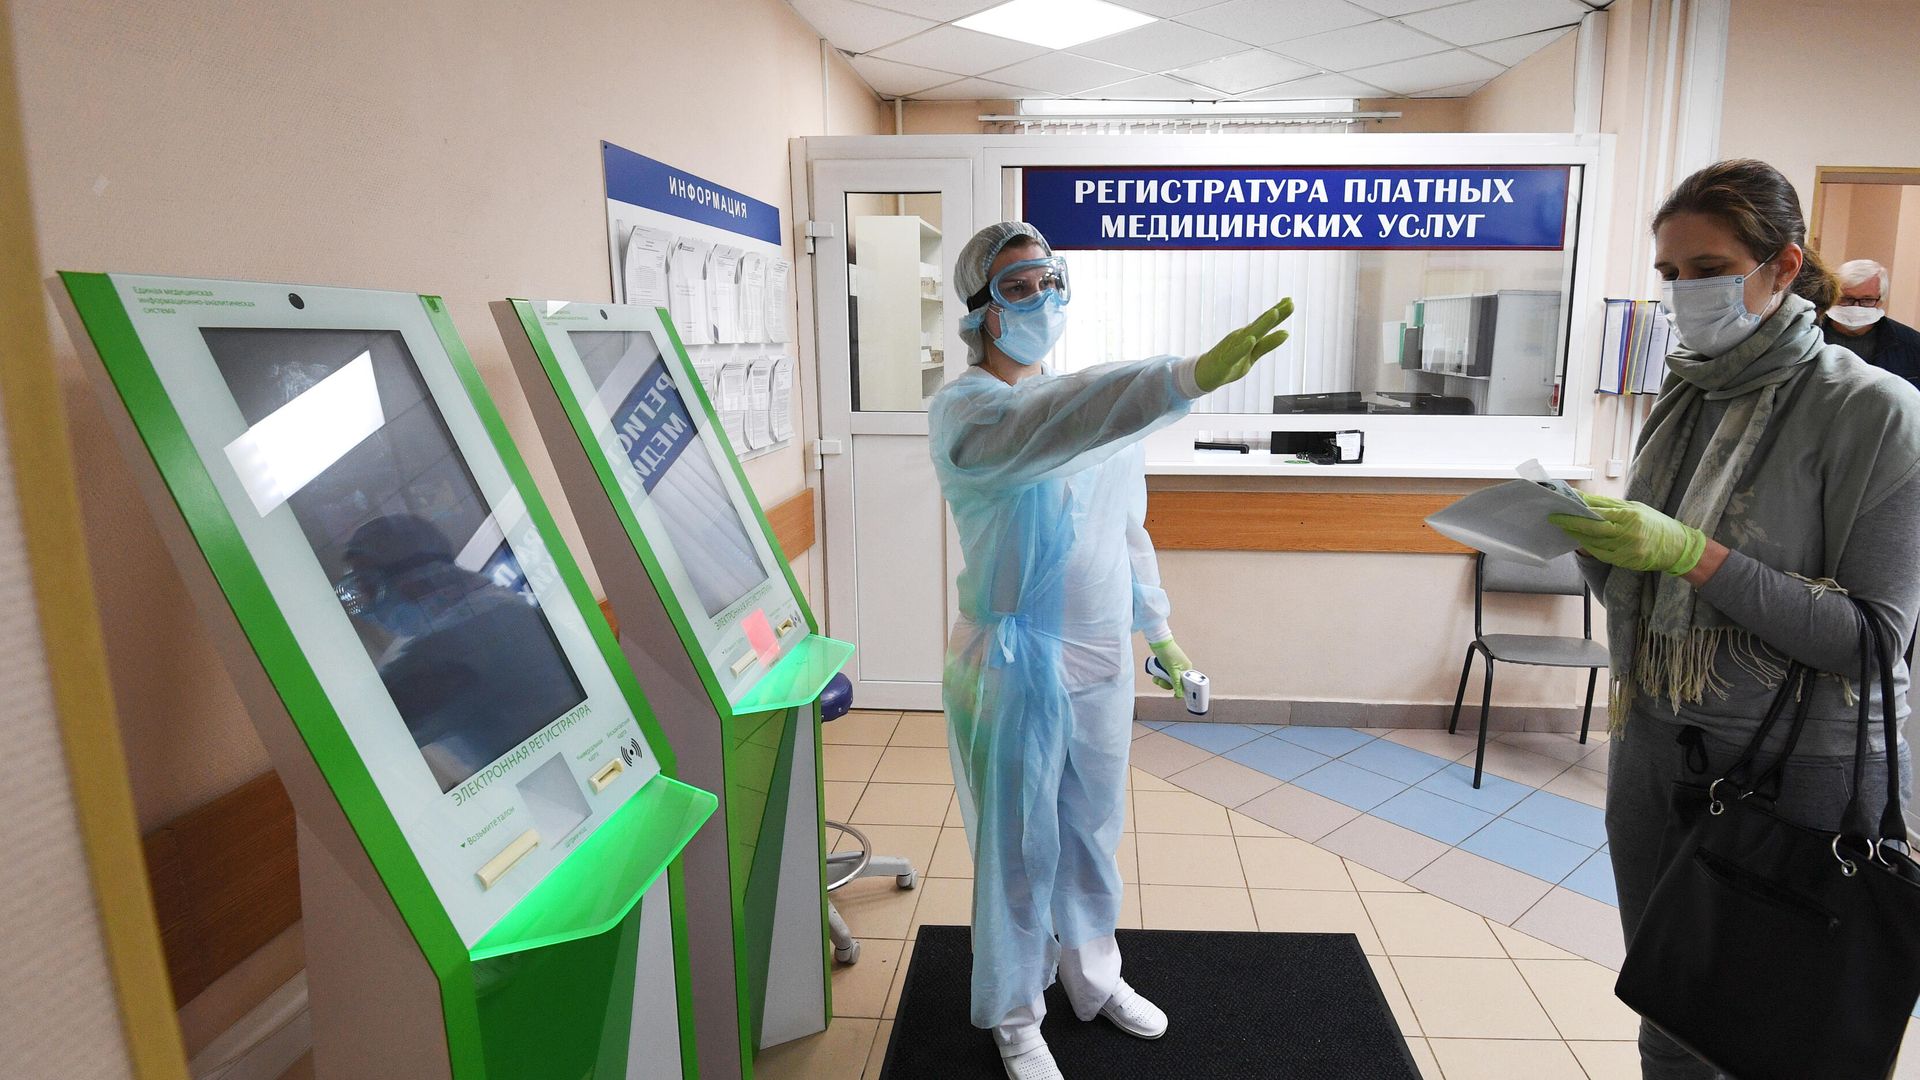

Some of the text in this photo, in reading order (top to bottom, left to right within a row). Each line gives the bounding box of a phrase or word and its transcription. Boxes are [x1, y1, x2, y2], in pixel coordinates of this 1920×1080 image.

[669, 175, 748, 219] ИНФОРМАЦИЯ
[1075, 178, 1514, 204] РЕГИСТРАТУРА ПЛАТНЫХ
[1101, 213, 1486, 242] МЕДИЦИНСКИХ УСЛУГ
[451, 704, 592, 807] ЭЛЕКТРОННАЯ РЕГИСТРАТУРА
[466, 817, 498, 846] Возьмите
